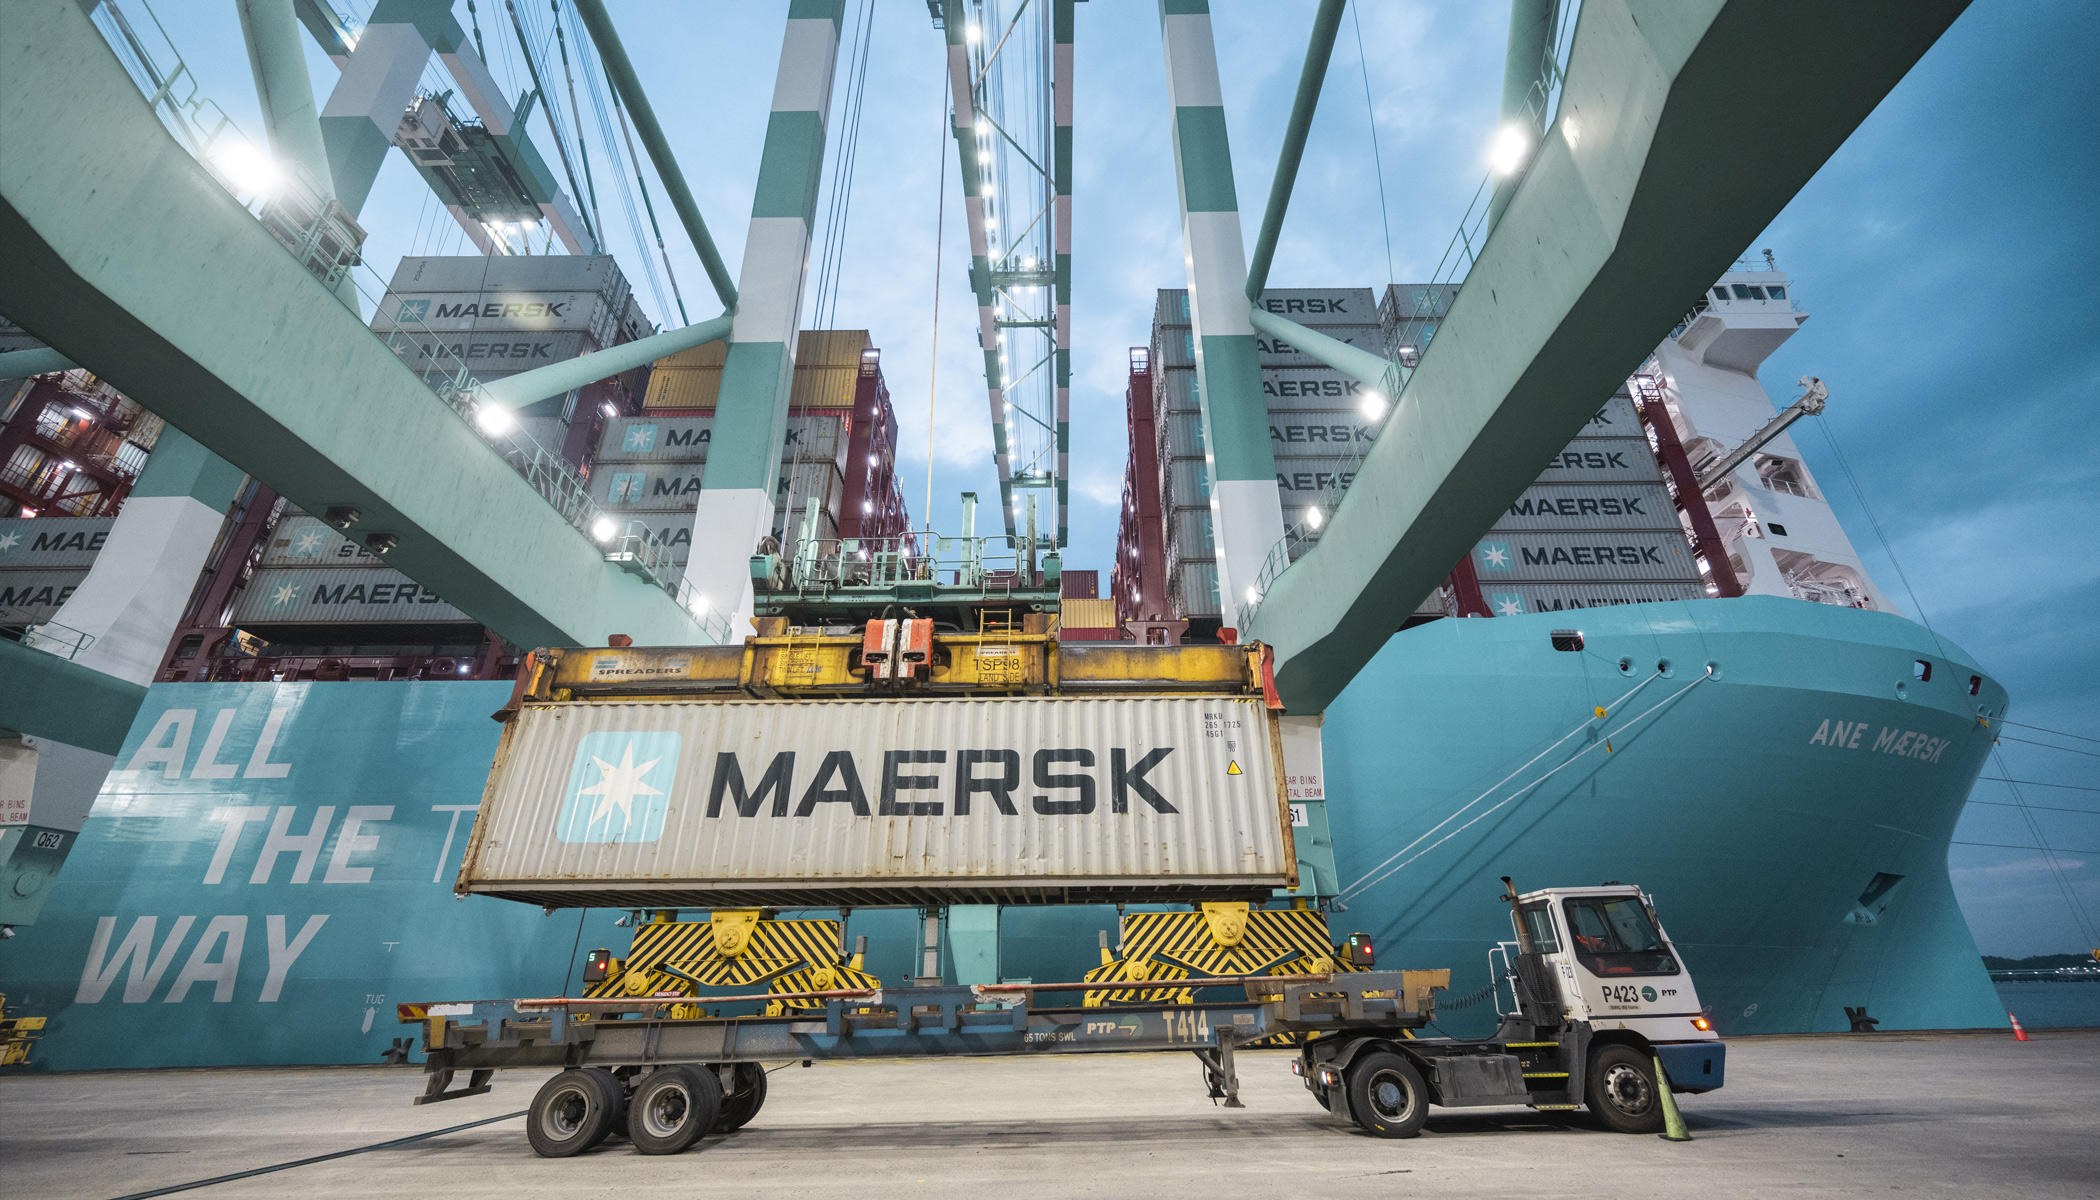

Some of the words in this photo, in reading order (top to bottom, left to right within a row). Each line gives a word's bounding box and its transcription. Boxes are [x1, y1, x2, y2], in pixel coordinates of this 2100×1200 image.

[435, 302, 566, 318] MAERSK
[1257, 299, 1348, 313] ERSK
[418, 342, 553, 359] MAERSK
[1263, 380, 1362, 397] AERSK
[1269, 425, 1375, 442] AERSK
[1546, 452, 1629, 469] ERSK
[1276, 472, 1356, 491] AERS
[1509, 498, 1646, 516] MAERSK
[31, 531, 110, 551] MAE
[1521, 546, 1664, 566] MAERSK
[0, 586, 78, 607] MAE
[312, 583, 450, 605] MAERS
[598, 667, 682, 676] SPREADERS
[972, 658, 1020, 671] TSP98
[1002, 672, 1020, 682] SDE
[1204, 712, 1223, 720] MRKU
[1204, 721, 1218, 729] 265
[1223, 720, 1241, 729] 1725
[1205, 730, 1223, 738] 45G1
[1808, 718, 1869, 749] ANE
[1871, 726, 1951, 764] MÆRSK
[117, 708, 292, 779] ALL
[706, 747, 1180, 818] MAERSK
[1300, 775, 1317, 785] BINS
[1304, 788, 1322, 798] BEAM
[7, 799, 26, 809] BINS
[10, 812, 28, 822] BEAM
[37, 832, 60, 848] Q62
[202, 805, 396, 885] THE
[74, 914, 331, 1004] WAY
[365, 994, 385, 1004] TUG
[1601, 985, 1639, 1003] P423
[1661, 989, 1677, 997] PTP
[1086, 1021, 1116, 1035] PTP
[1162, 1010, 1209, 1043] T414
[1024, 1033, 1034, 1043] 65
[1034, 1032, 1057, 1042] TONS
[1058, 1031, 1077, 1042] SWL
